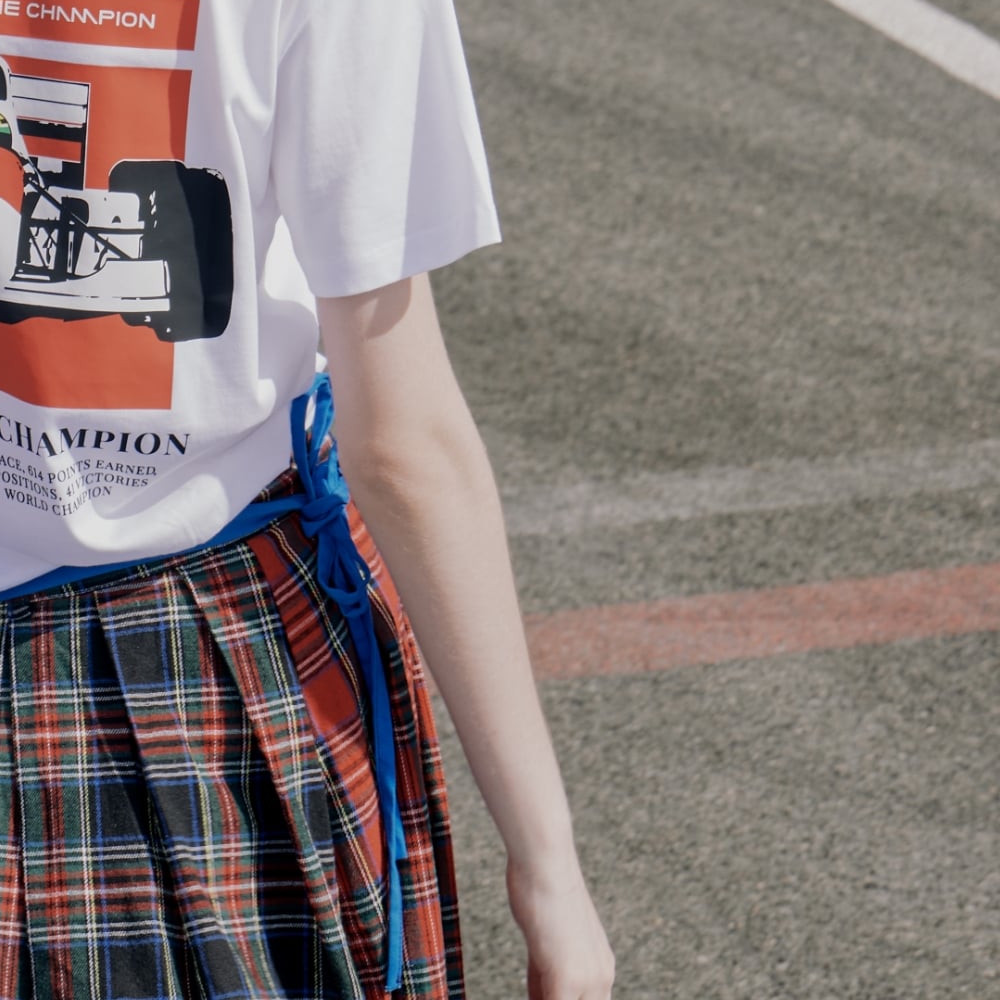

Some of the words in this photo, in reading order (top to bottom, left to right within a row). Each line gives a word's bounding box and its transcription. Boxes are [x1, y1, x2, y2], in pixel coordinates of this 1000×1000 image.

[26, 2, 156, 30] CHAMPION
[27, 464, 44, 481] 614
[48, 459, 91, 484] POINTS
[66, 483, 75, 498] 41
[74, 472, 149, 488] VICTORIES
[4, 487, 49, 512] WORLD
[52, 486, 113, 517] CHAMPION
